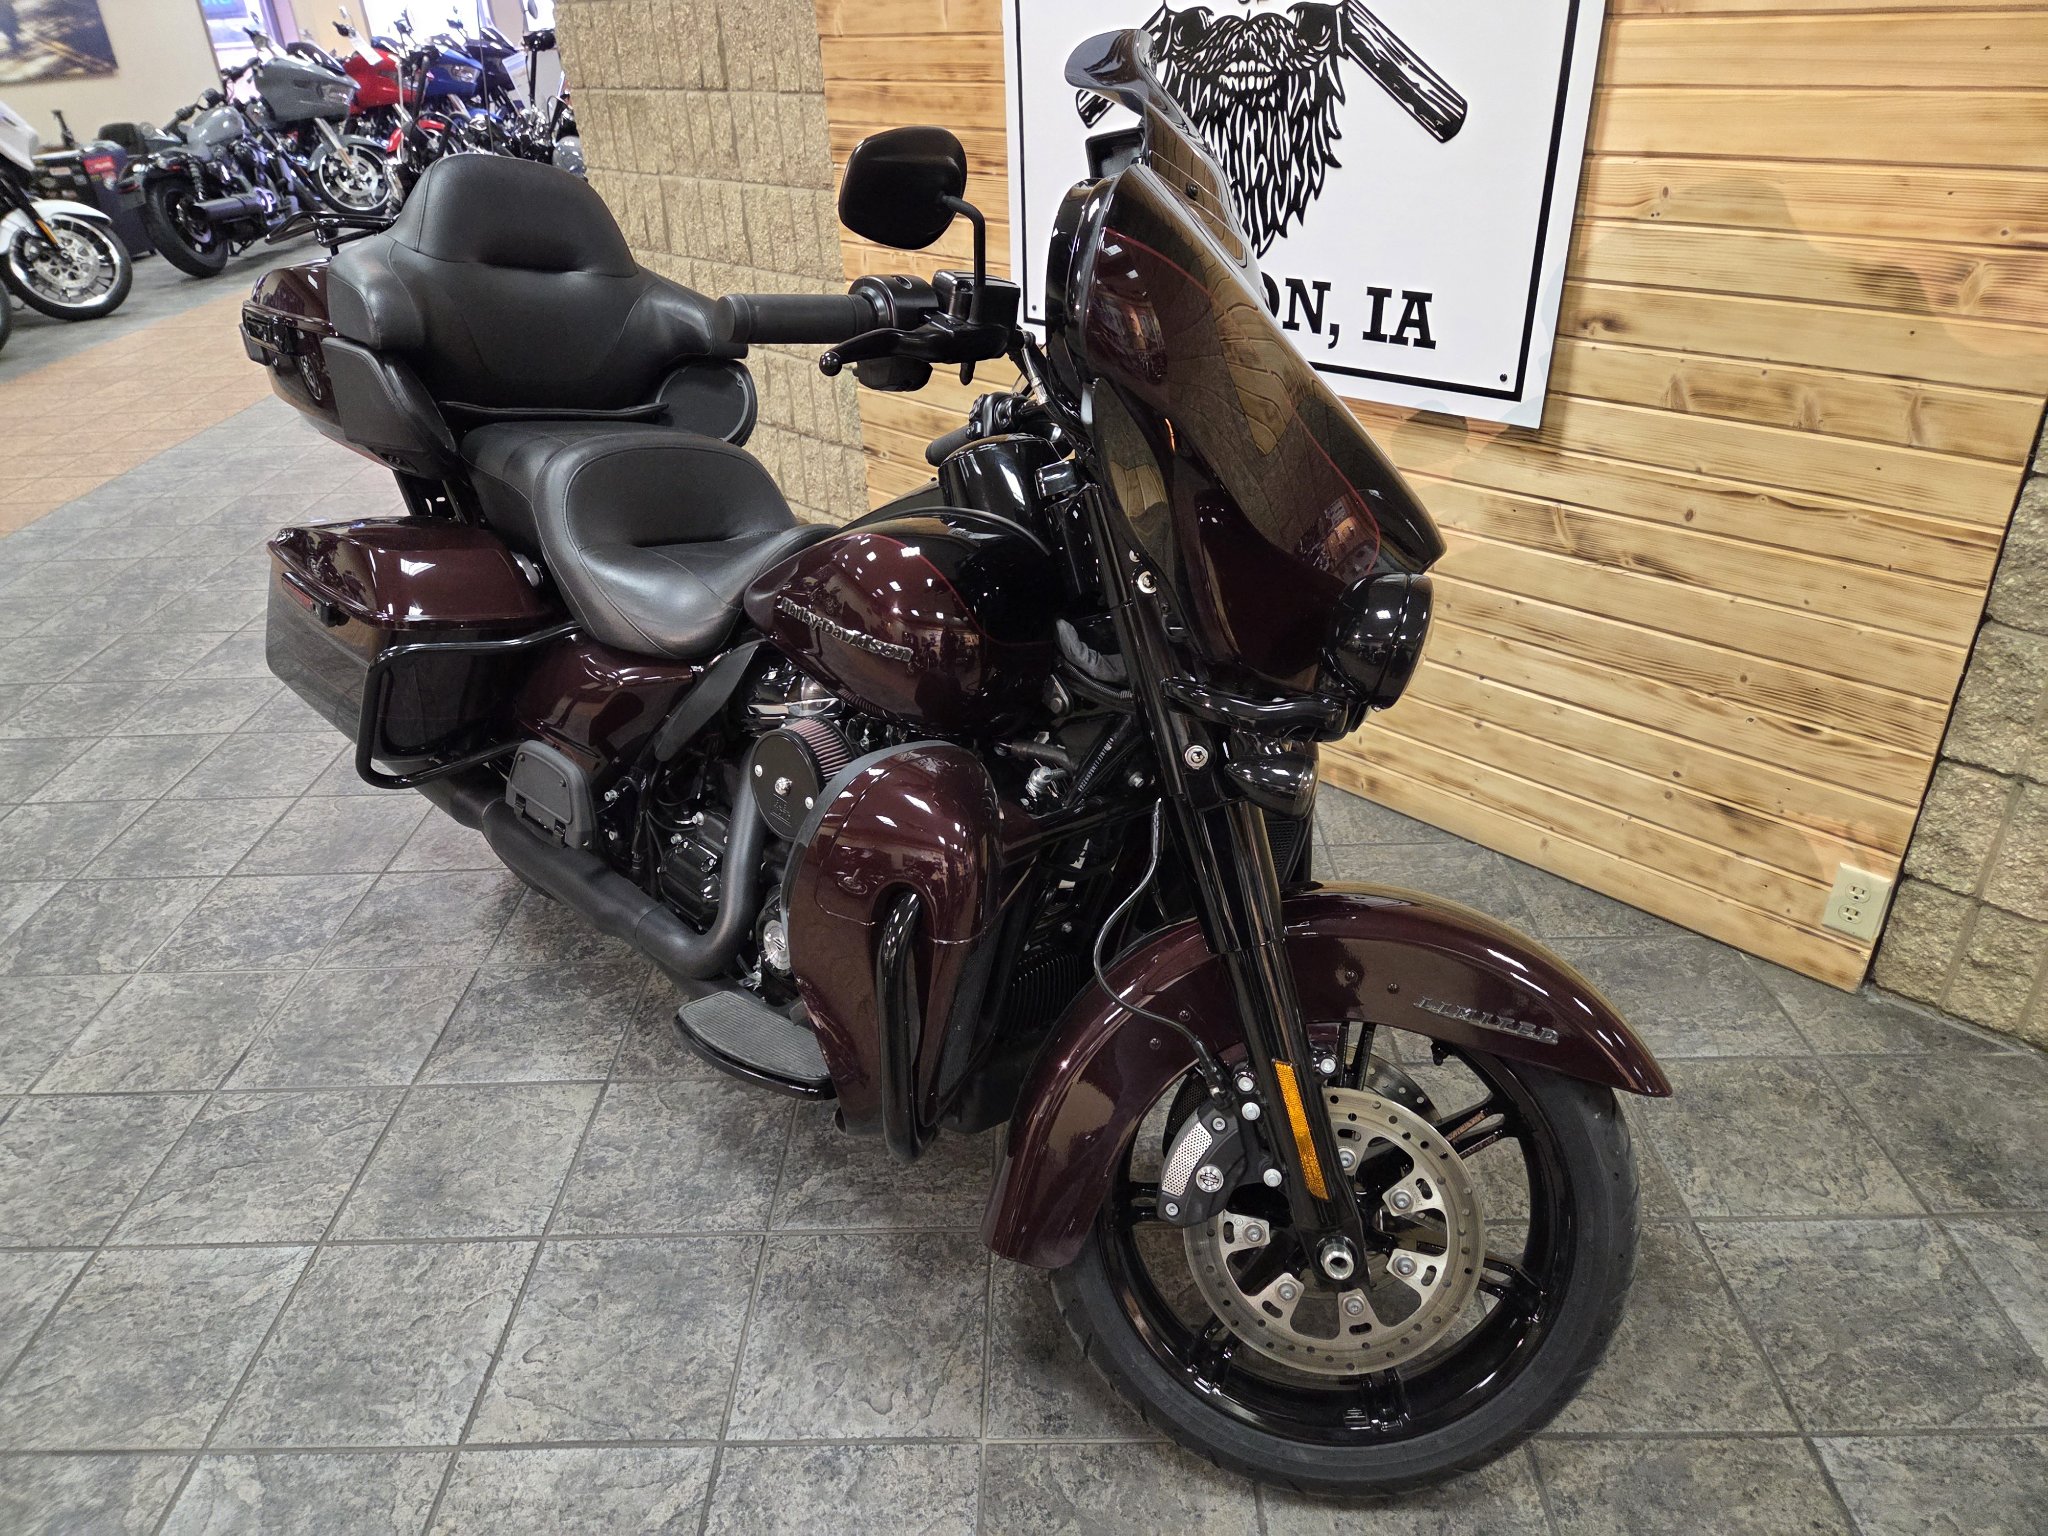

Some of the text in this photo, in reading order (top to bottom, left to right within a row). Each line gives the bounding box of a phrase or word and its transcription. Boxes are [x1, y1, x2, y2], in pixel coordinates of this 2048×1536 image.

[1362, 286, 1436, 349] IA
[781, 597, 914, 662] Harley-Davidson
[1413, 996, 1559, 1046] LIMITED
